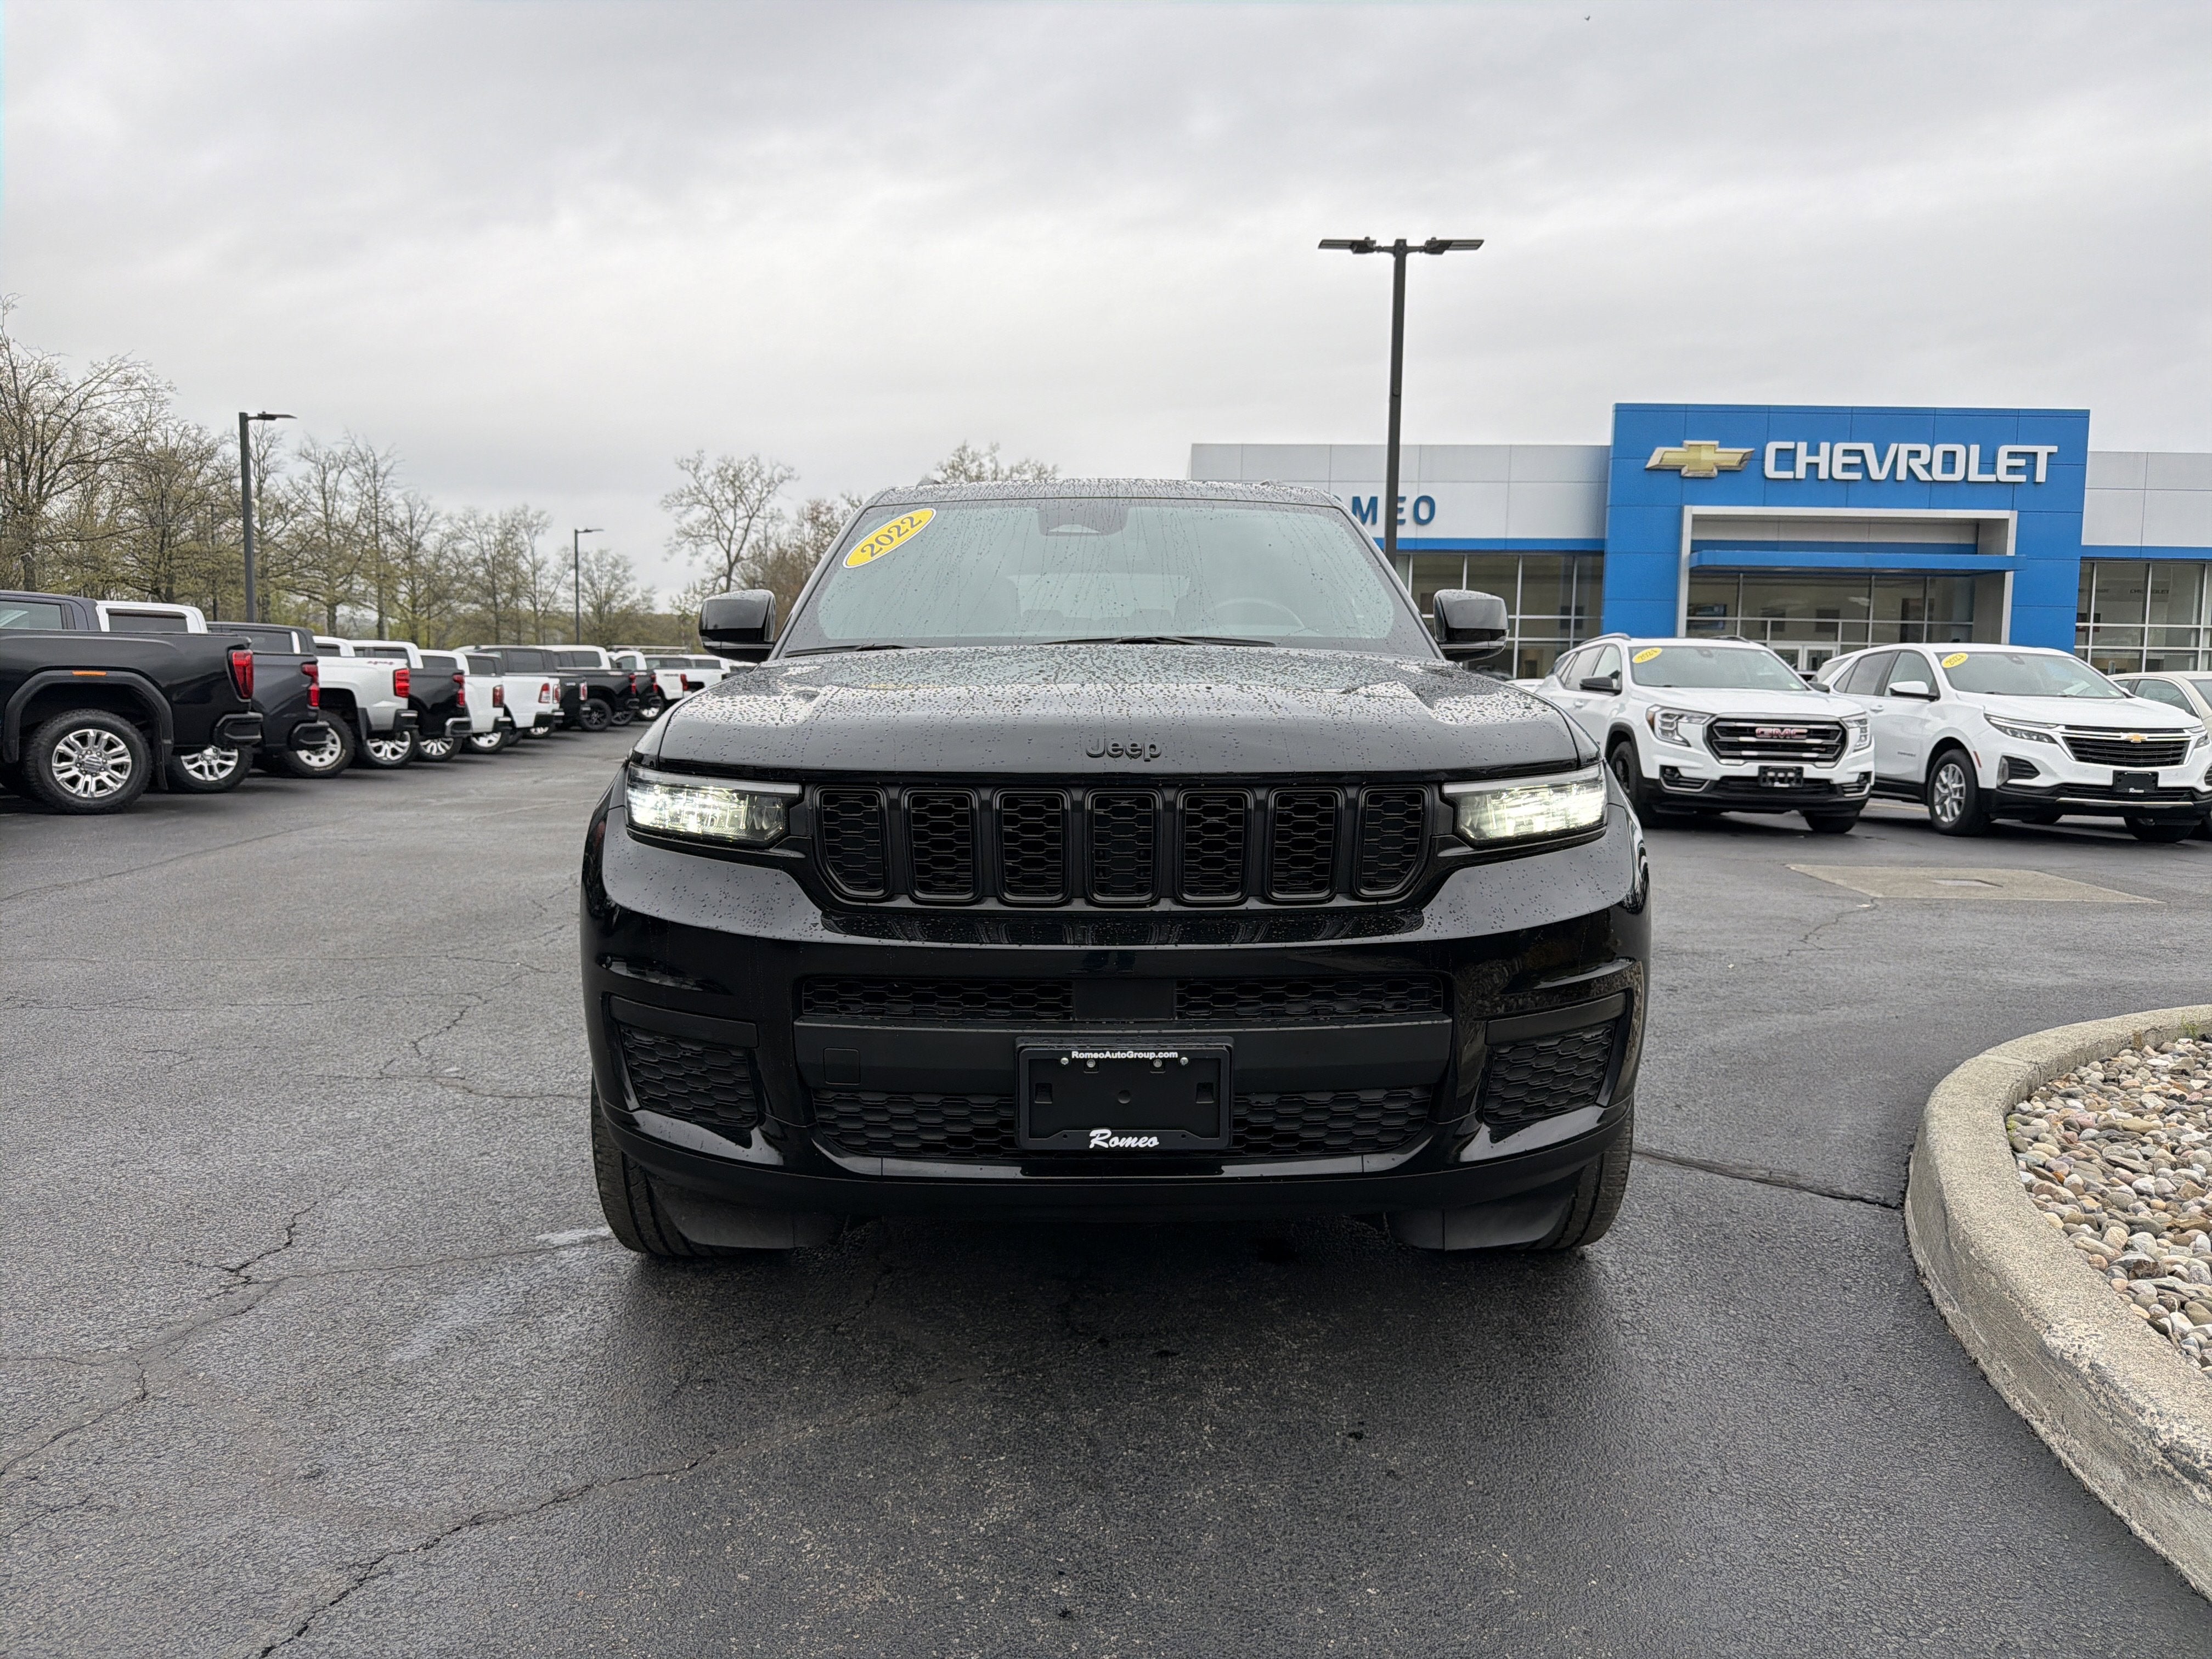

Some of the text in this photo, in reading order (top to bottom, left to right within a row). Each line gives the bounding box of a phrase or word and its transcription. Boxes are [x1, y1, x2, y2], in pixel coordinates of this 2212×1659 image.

[1764, 441, 2058, 483] CHEVROLET
[1334, 495, 1436, 526] MEO
[860, 516, 923, 558] 2022
[1755, 727, 1808, 739] GMC
[1085, 736, 1162, 762] Jeep
[1071, 1050, 1178, 1060] RomeoAutoGroup.com
[1088, 1128, 1160, 1149] Romeo
